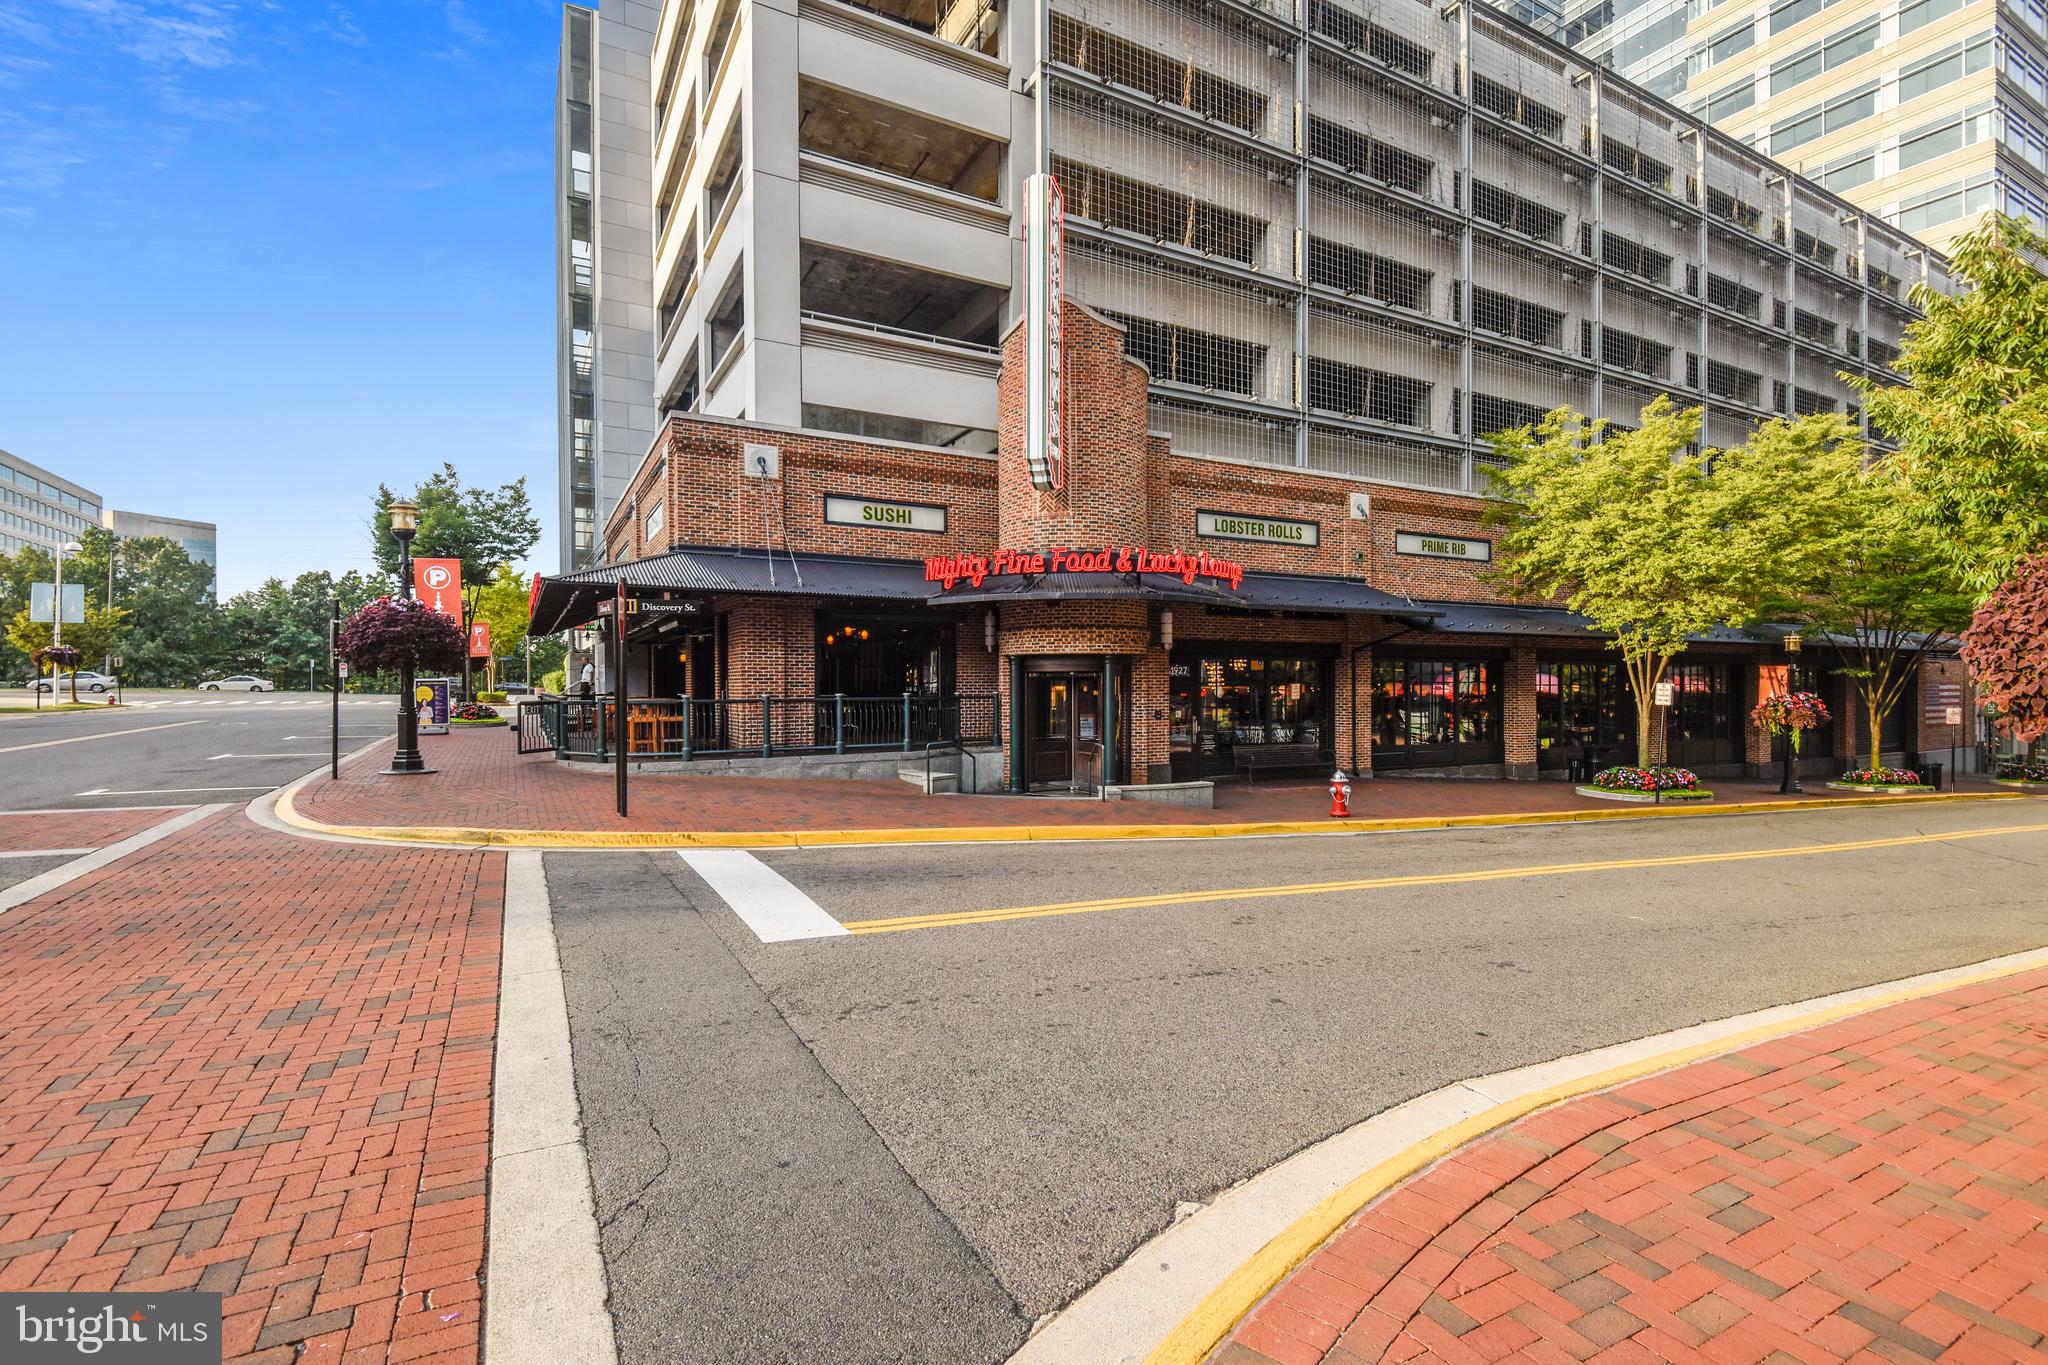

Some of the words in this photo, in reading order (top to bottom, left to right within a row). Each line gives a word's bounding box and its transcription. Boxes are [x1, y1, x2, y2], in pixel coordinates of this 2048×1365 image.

[863, 505, 912, 524] SUSHI
[1214, 518, 1265, 537] LOBSTER
[1268, 524, 1303, 540] ROLLS
[1421, 539, 1450, 554] PRIME
[1451, 542, 1466, 555] RIB
[925, 554, 990, 590] Mighty
[992, 549, 1045, 575] Fine
[1051, 545, 1113, 574] Food
[1115, 546, 1133, 572] &
[1135, 546, 1199, 585] Lucky
[429, 569, 447, 586] P
[641, 602, 684, 614] Discovery
[684, 603, 696, 612] St.
[527, 705, 540, 714] EXIT
